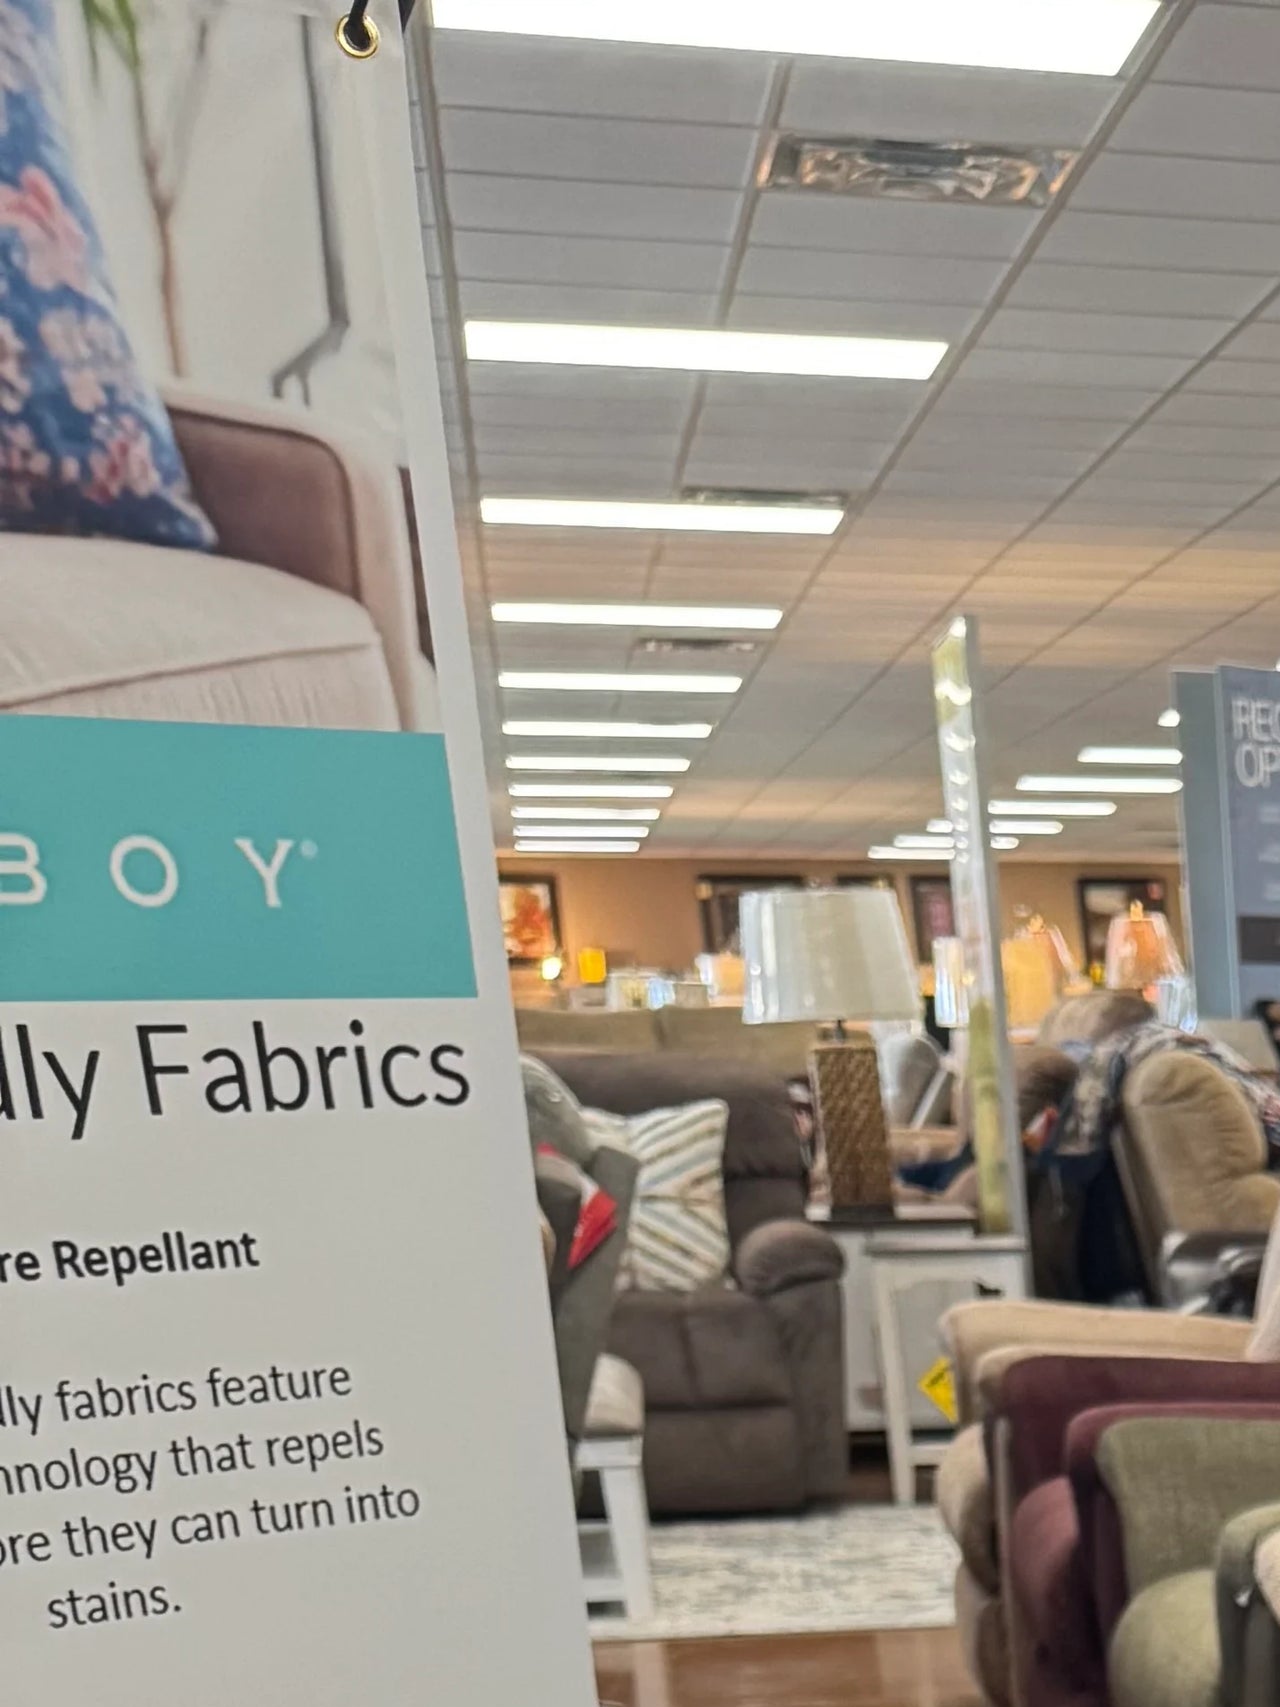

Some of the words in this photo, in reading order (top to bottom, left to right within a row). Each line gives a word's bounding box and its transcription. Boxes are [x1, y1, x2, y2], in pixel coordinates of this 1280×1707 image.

[135, 1019, 470, 1115] Fabrics
[52, 1231, 260, 1287] Repellant
[54, 1374, 197, 1421] fabrics
[206, 1366, 351, 1407] feature
[168, 1434, 256, 1476] that
[266, 1419, 383, 1472] repels
[62, 1516, 157, 1559] they
[171, 1510, 240, 1544] can
[250, 1499, 335, 1534] turn
[344, 1484, 419, 1523] into
[48, 1581, 181, 1629] stains.
